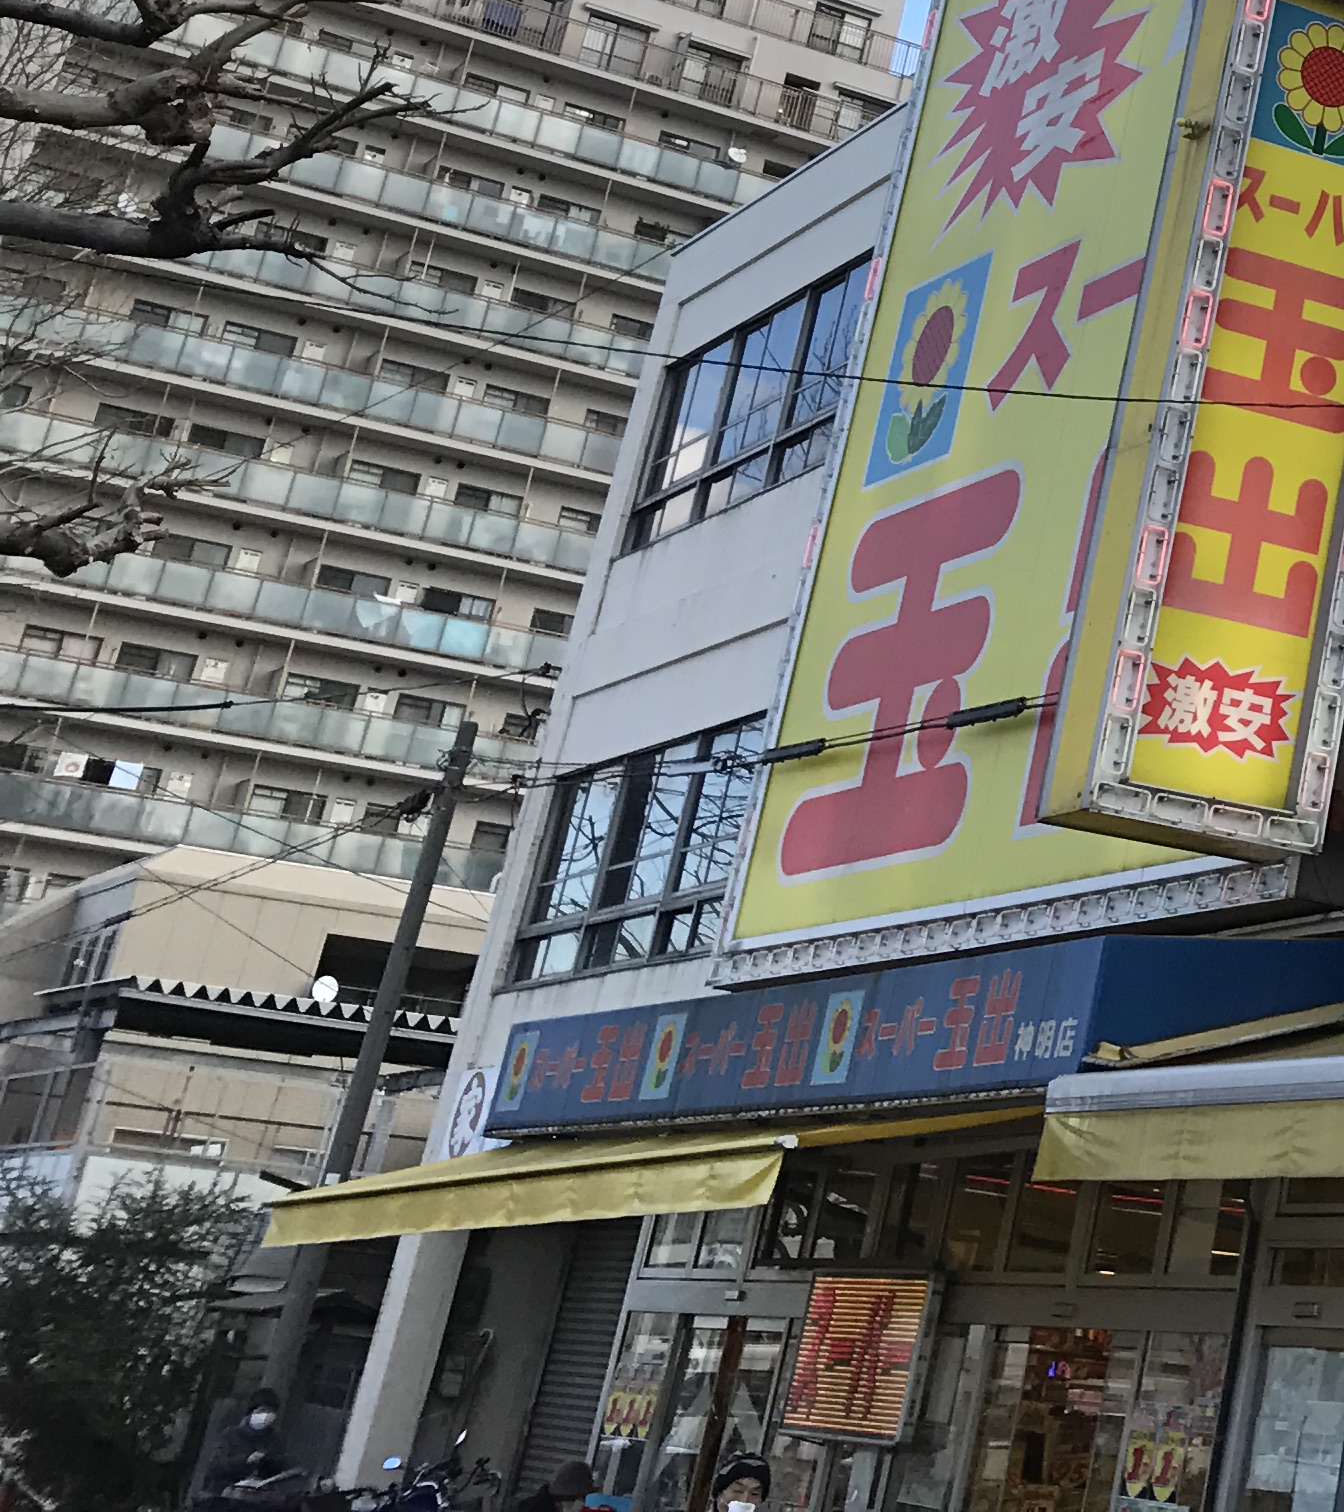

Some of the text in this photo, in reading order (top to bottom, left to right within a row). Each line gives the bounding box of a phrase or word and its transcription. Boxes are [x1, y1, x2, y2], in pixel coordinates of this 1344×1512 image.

[780, 450, 1108, 880] 玉
[1159, 672, 1272, 750] 激安
[1013, 1016, 1077, 1059] 神明店
